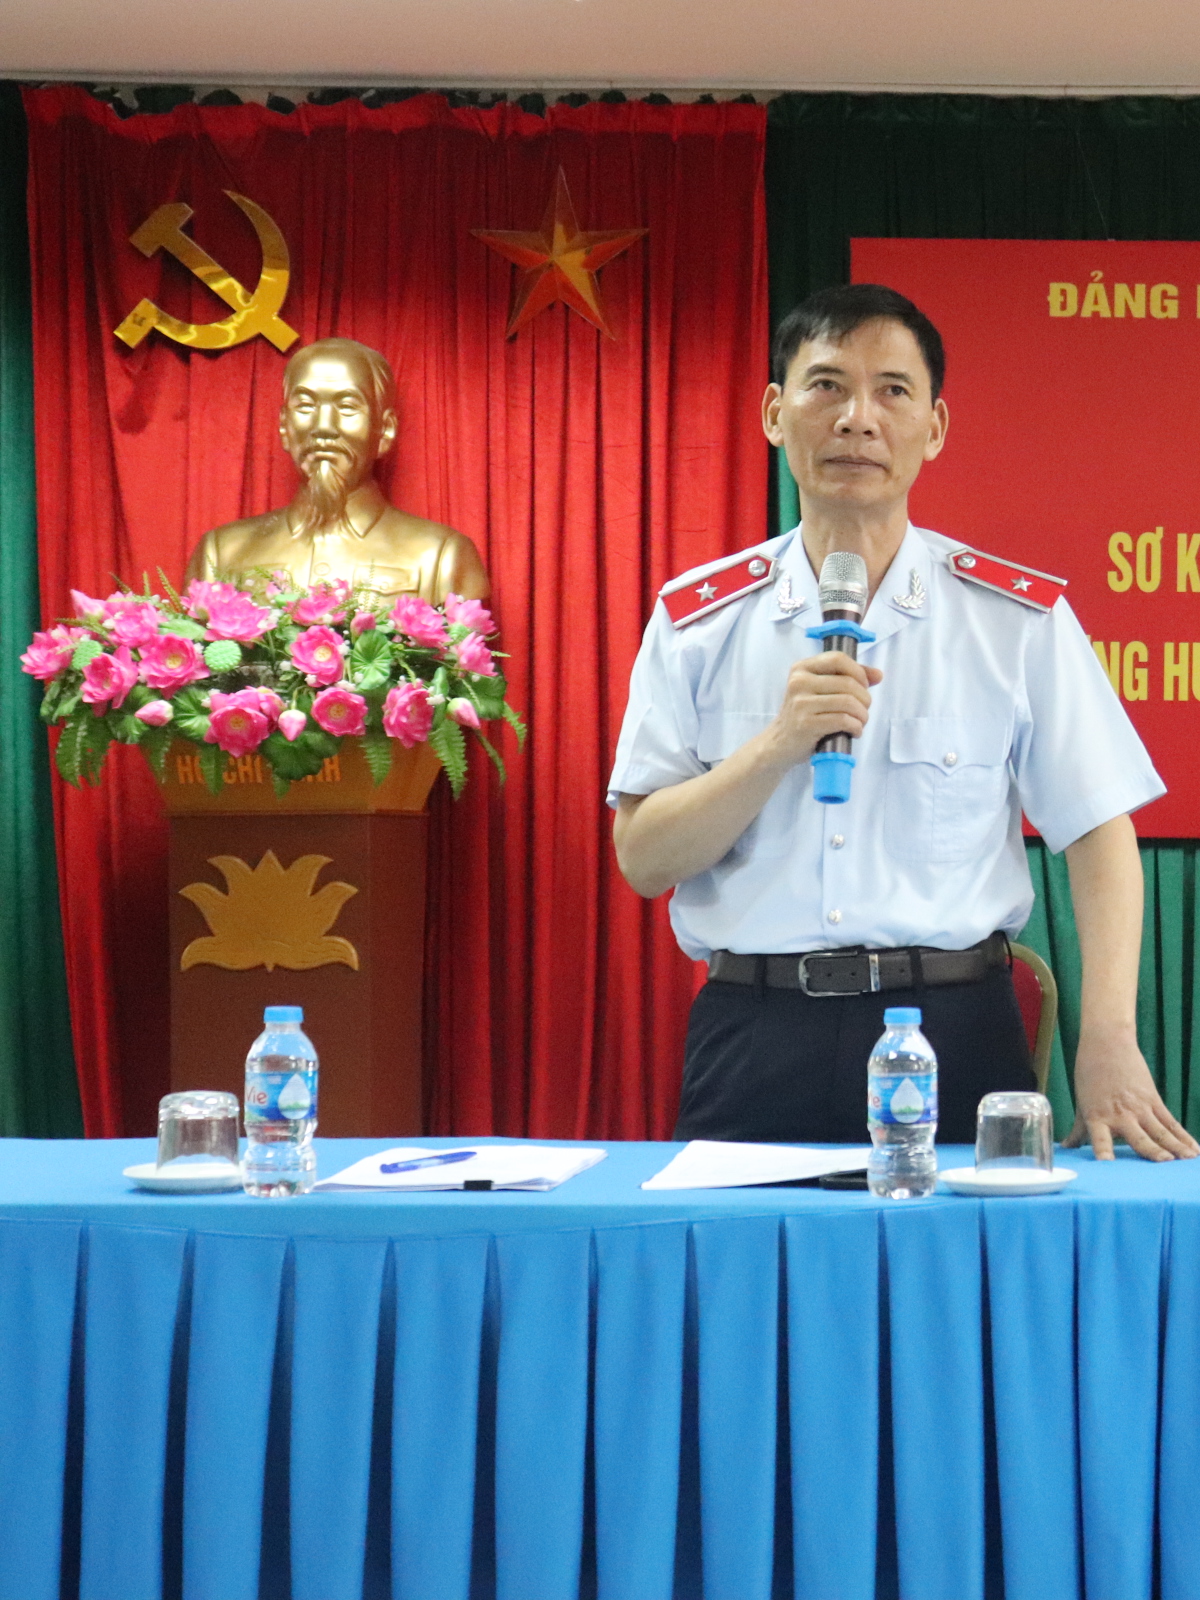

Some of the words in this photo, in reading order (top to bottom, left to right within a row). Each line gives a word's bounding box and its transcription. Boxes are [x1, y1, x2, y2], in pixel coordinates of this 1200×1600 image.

[1047, 270, 1179, 320] ĐẢNG
[1108, 527, 1165, 594] SƠ
[1086, 634, 1149, 702] NG
